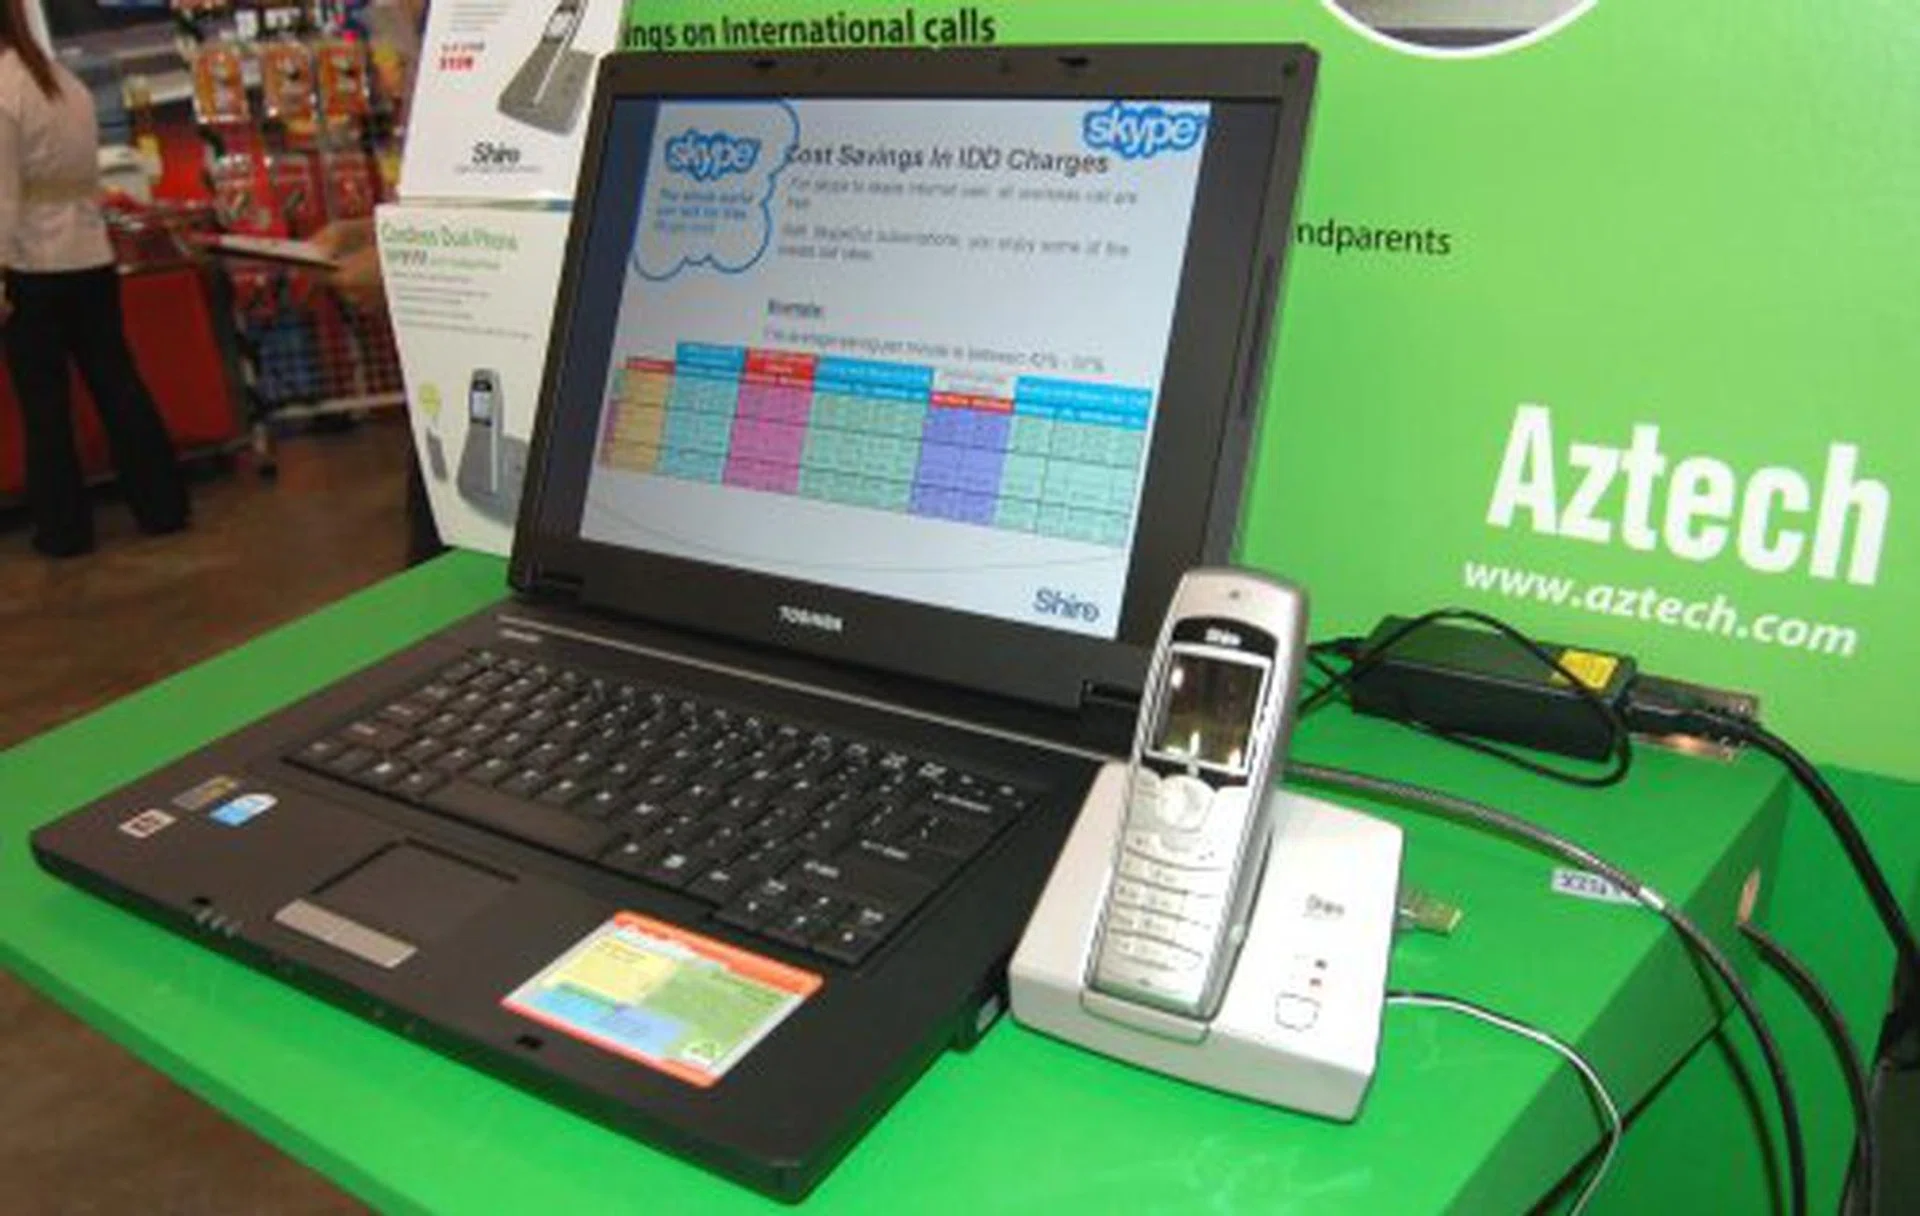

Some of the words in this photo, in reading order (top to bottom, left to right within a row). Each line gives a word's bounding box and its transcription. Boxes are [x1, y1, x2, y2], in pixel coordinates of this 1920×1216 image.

[682, 23, 716, 46] on
[723, 9, 914, 45] International
[924, 9, 996, 43] calls
[1085, 101, 1204, 158] skype
[472, 141, 521, 163] Shiro
[666, 129, 760, 181] skype
[837, 145, 923, 173] Savings
[959, 147, 1001, 170] IDD
[1006, 149, 1109, 177] Charges
[1297, 218, 1452, 255] ndparents
[1486, 403, 1890, 586] Aztech
[1034, 588, 1100, 623] Shiro
[1463, 560, 1858, 657] www.aztech.com
